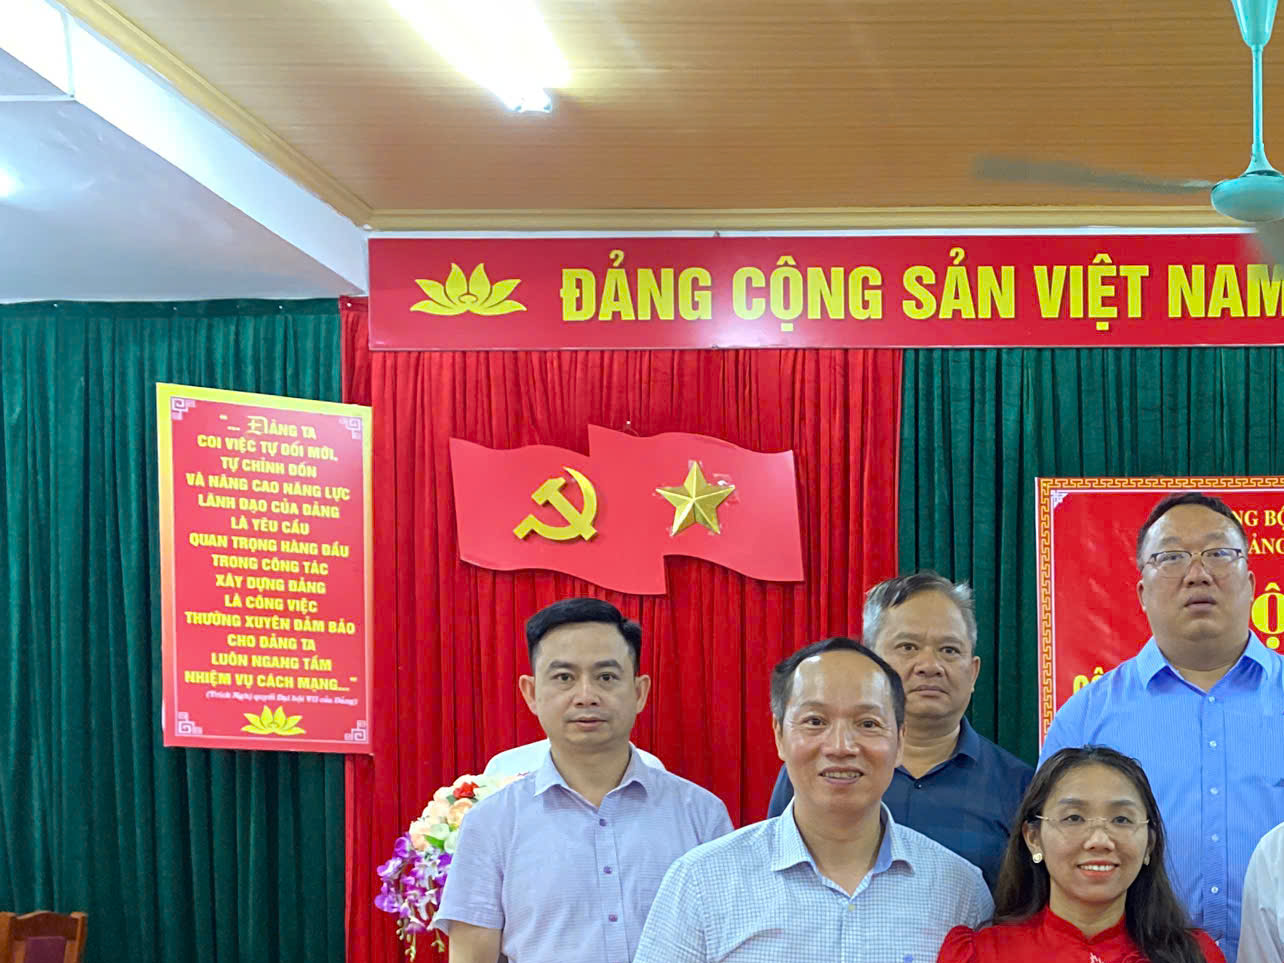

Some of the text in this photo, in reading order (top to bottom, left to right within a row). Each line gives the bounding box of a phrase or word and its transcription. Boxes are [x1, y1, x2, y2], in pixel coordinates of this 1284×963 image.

[560, 248, 712, 321] ĐẢNG
[732, 257, 882, 332] CỘNG
[902, 247, 1015, 321] SẢN
[1037, 253, 1149, 331] VIỆT
[301, 426, 316, 440] TA
[197, 435, 221, 448] COI
[225, 437, 256, 453] VIỆC
[252, 480, 279, 493] CAO
[271, 499, 299, 514] CỦA
[231, 516, 248, 529] LÀ
[1235, 510, 1258, 526] NG
[190, 533, 228, 548] QUAN
[212, 554, 258, 570] TRONG
[262, 557, 299, 572] CÔNG
[216, 572, 242, 588] XÂY
[224, 593, 317, 614] LÀ CÔNG VIỆC
[245, 615, 290, 630] XUYÊN
[227, 634, 256, 647] CHO
[301, 638, 316, 651] TA
[212, 652, 248, 666] LUÔN
[252, 655, 299, 669] NGANG
[235, 673, 253, 689] VỤ
